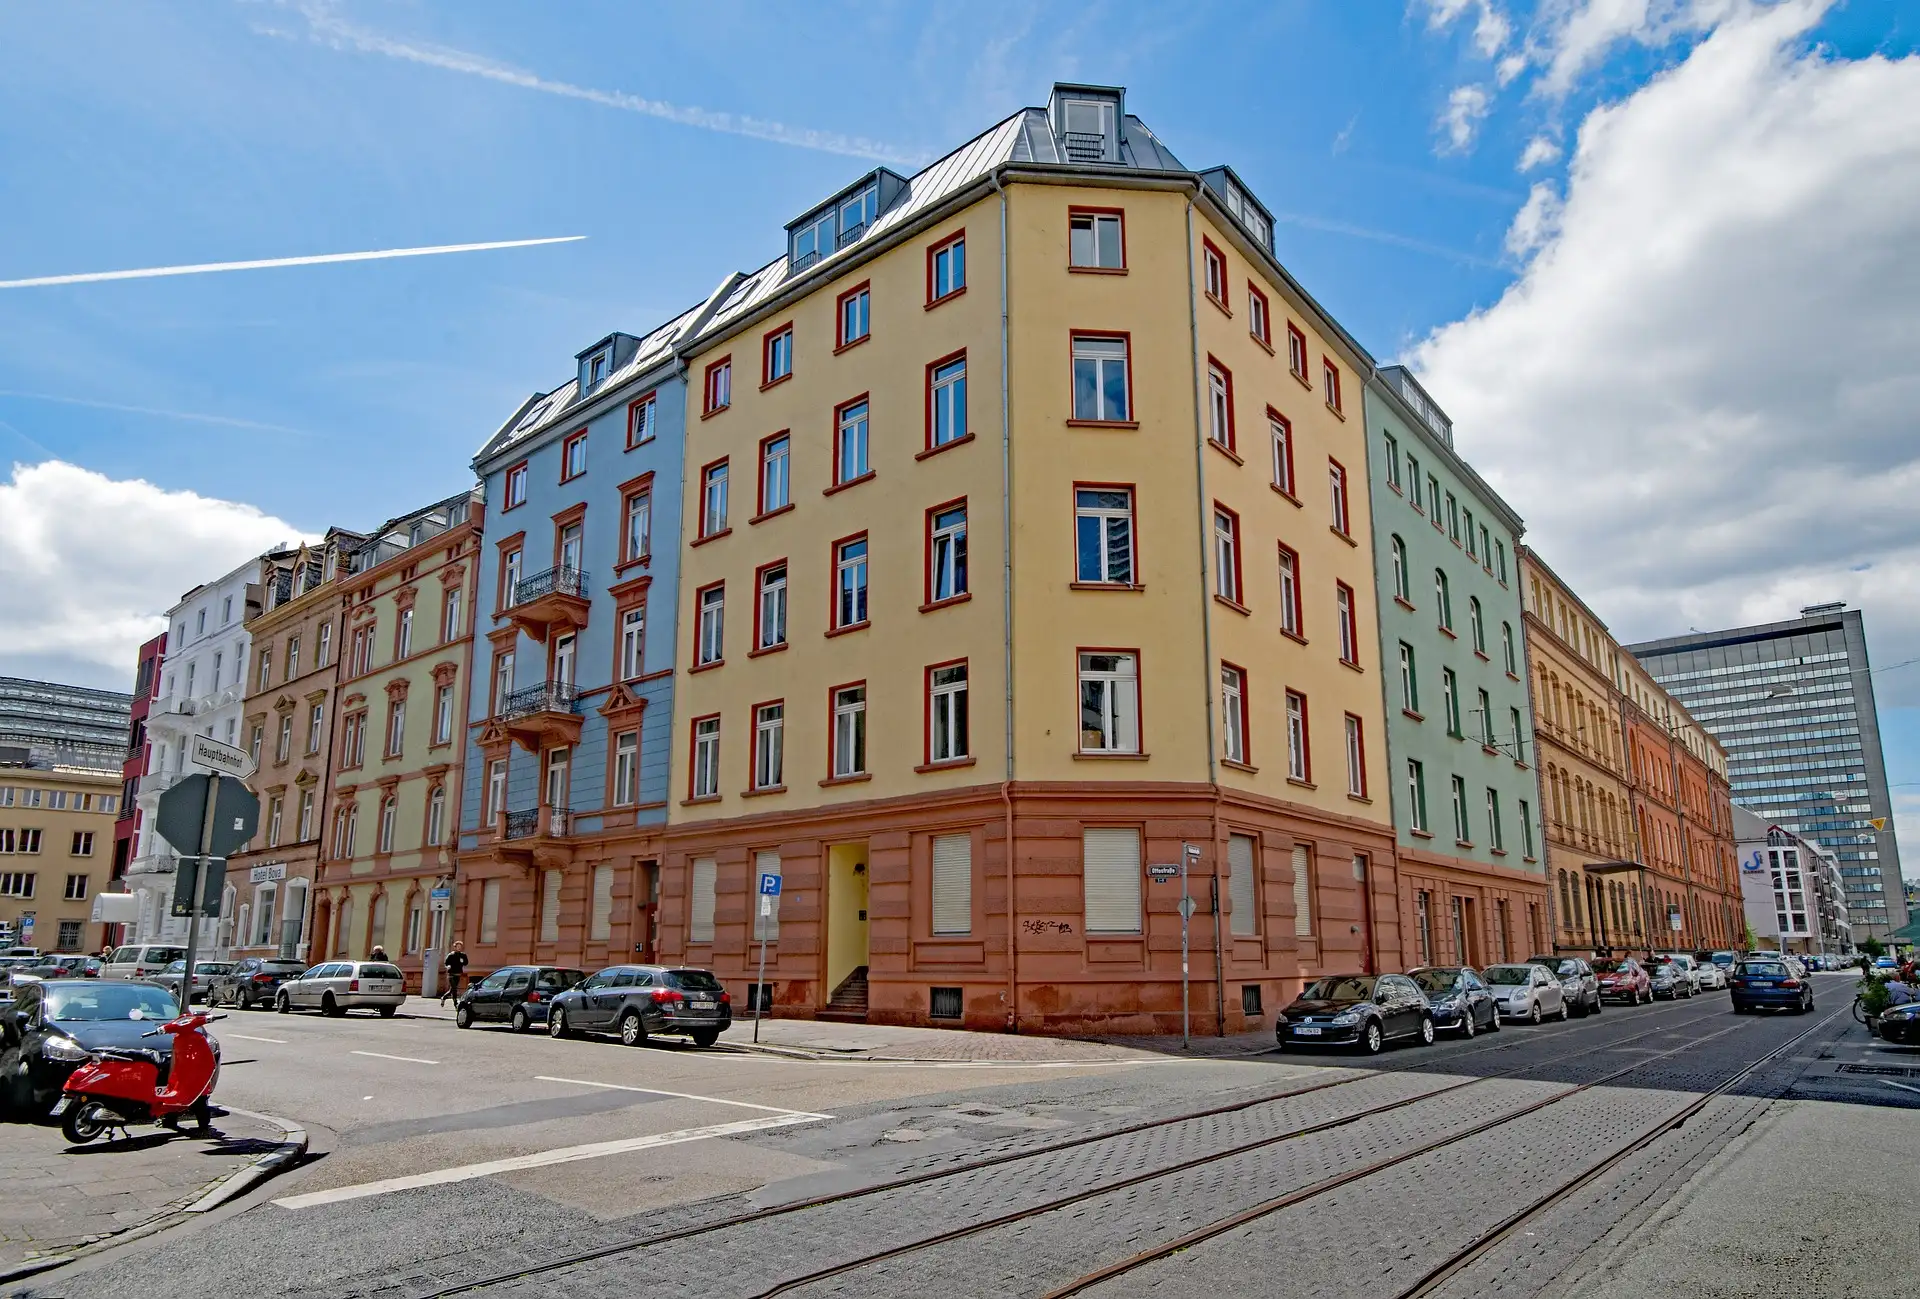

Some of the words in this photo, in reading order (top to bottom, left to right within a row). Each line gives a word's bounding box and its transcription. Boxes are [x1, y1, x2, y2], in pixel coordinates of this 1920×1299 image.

[198, 743, 243, 769] Hauptbahnhof
[253, 868, 268, 881] Hotel
[269, 867, 282, 879] Bova
[763, 877, 775, 892] P
